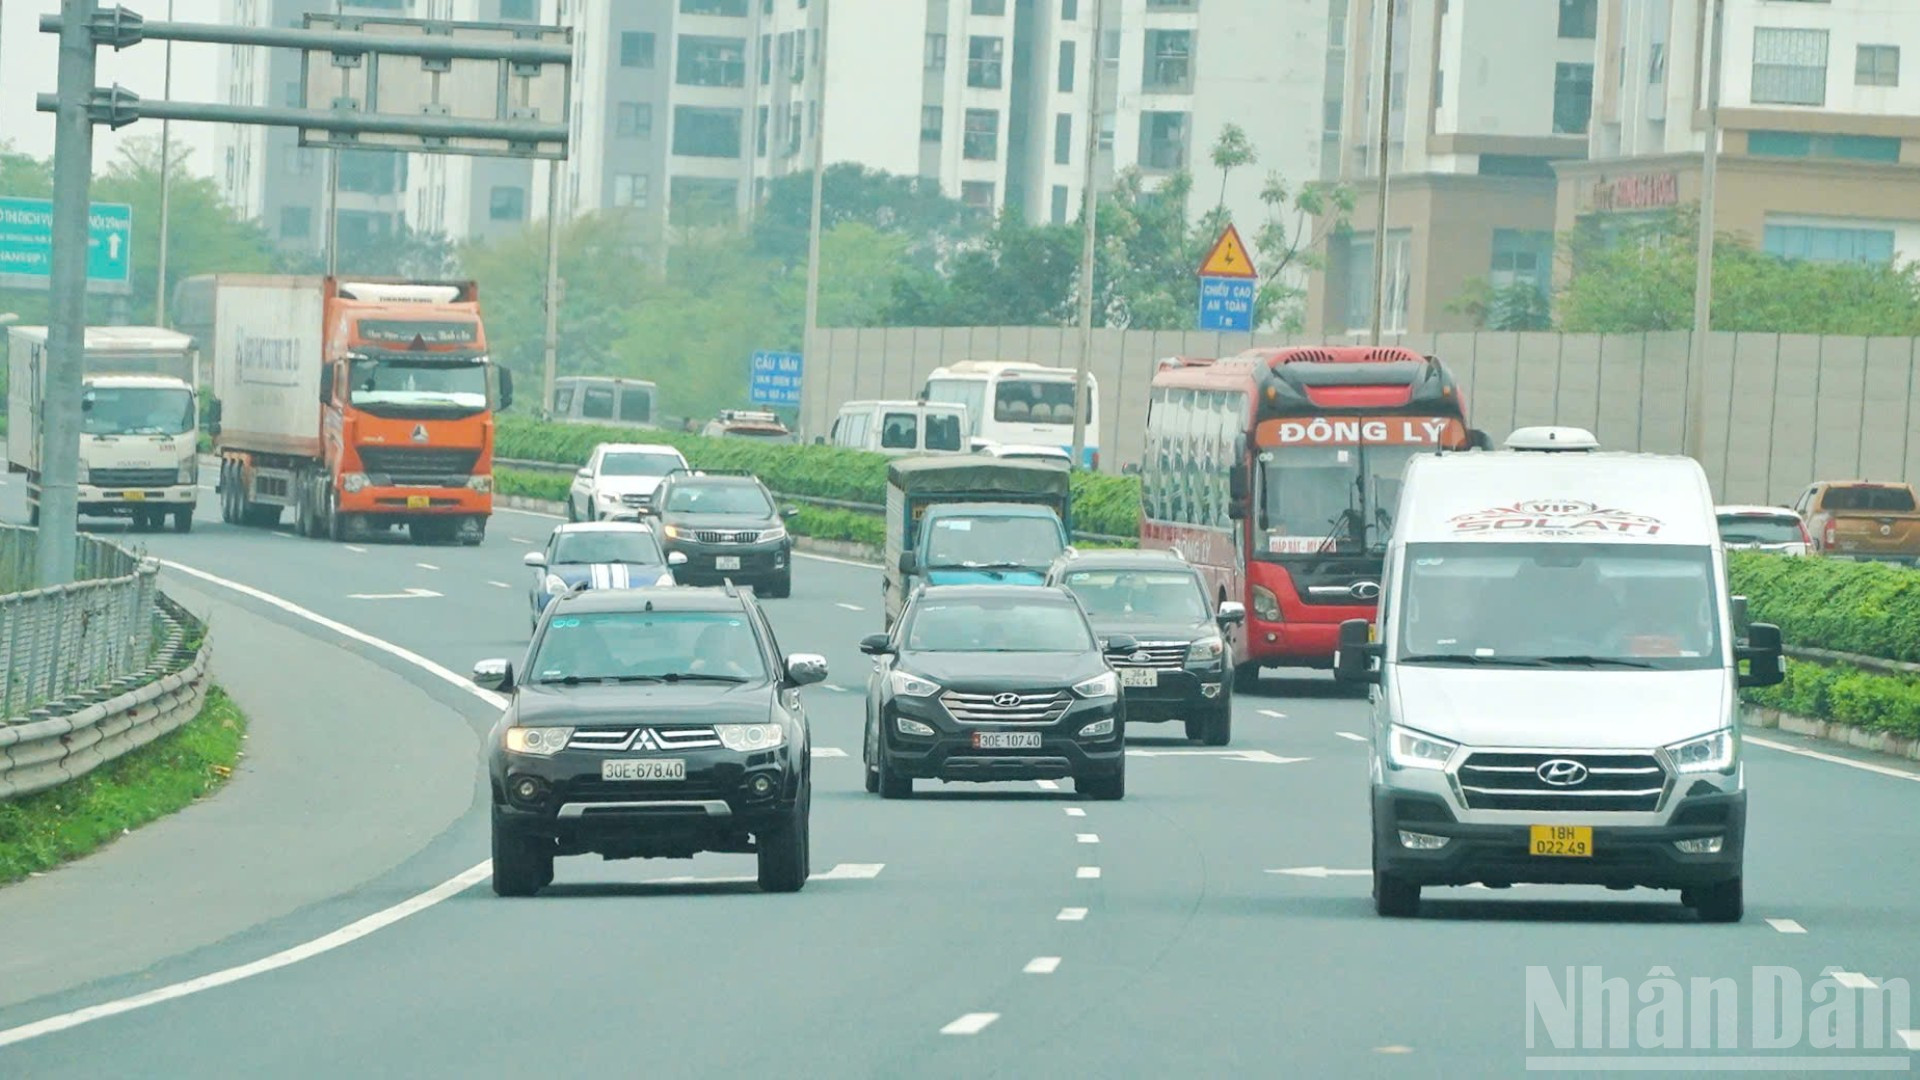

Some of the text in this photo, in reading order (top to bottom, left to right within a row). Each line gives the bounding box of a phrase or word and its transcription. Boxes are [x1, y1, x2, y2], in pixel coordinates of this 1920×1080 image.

[1233, 285, 1251, 298] CAO
[1279, 417, 1446, 442] ĐÔNG LÝ
[1533, 504, 1580, 513] VIP
[1452, 518, 1661, 536] SOLATI
[982, 735, 1040, 747] 30E-107.40
[606, 763, 683, 779] 30E-678.40
[1551, 826, 1575, 839] 18H
[1536, 840, 1586, 855] 022.49
